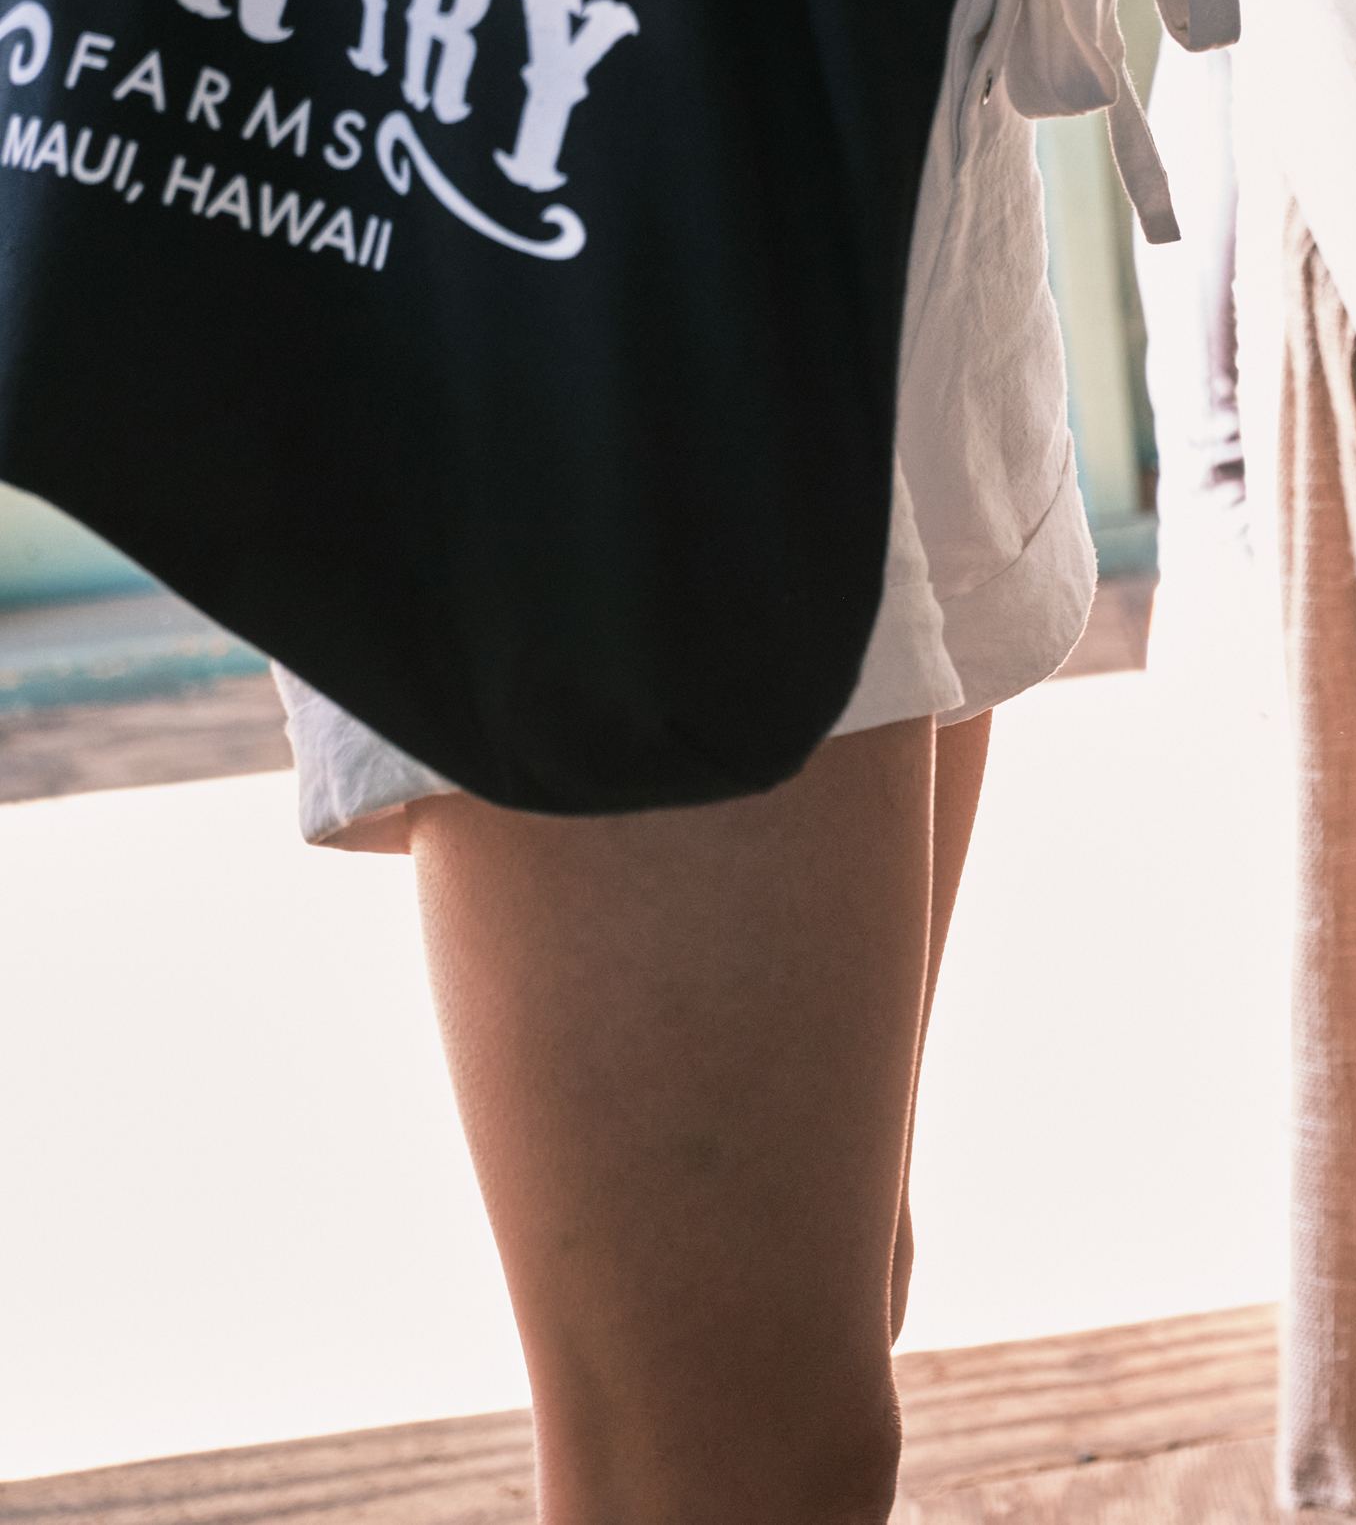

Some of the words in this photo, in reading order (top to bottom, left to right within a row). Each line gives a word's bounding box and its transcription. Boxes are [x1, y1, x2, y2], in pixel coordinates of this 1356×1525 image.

[65, 31, 367, 171] FARMS
[2, 116, 145, 202] MAUI,
[162, 154, 394, 271] HAWAII
